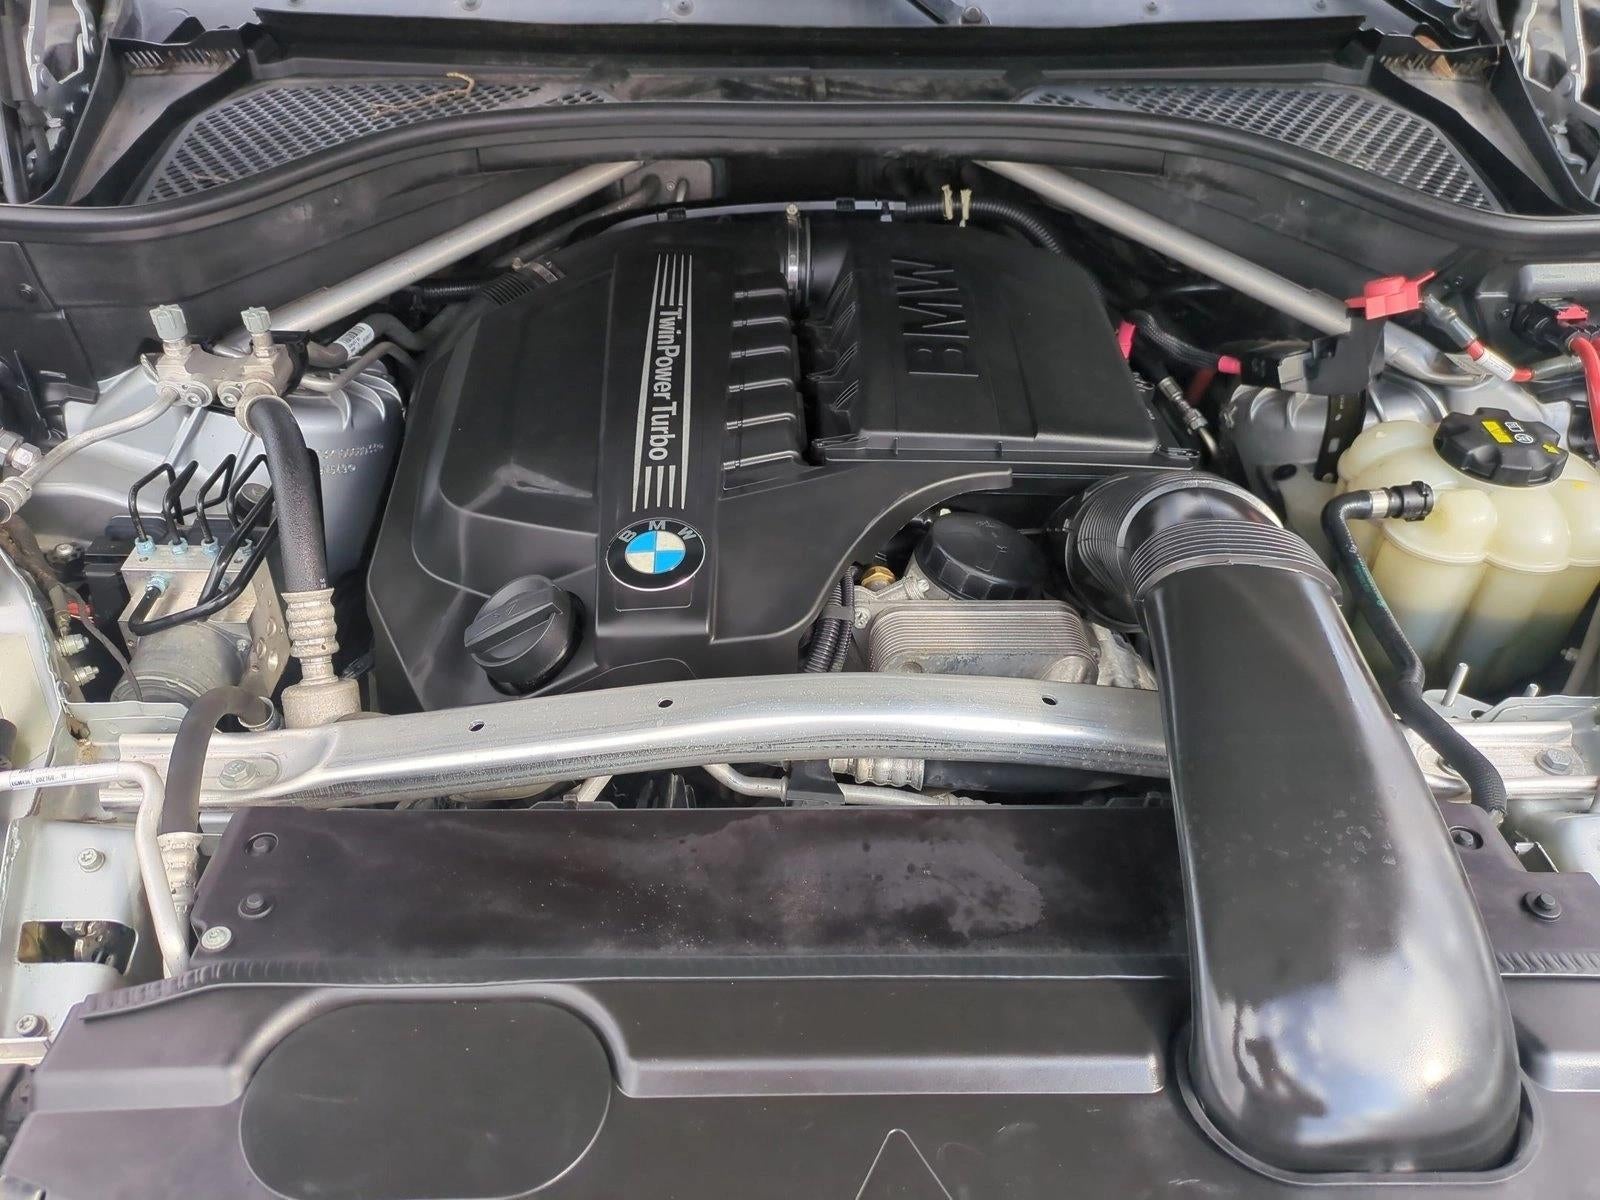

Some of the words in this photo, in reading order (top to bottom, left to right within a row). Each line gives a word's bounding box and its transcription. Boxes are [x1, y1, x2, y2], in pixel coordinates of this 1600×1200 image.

[653, 307, 683, 400] TwinPower
[891, 257, 979, 378] BMW
[649, 401, 678, 461] Turbo
[618, 519, 697, 543] BMW
